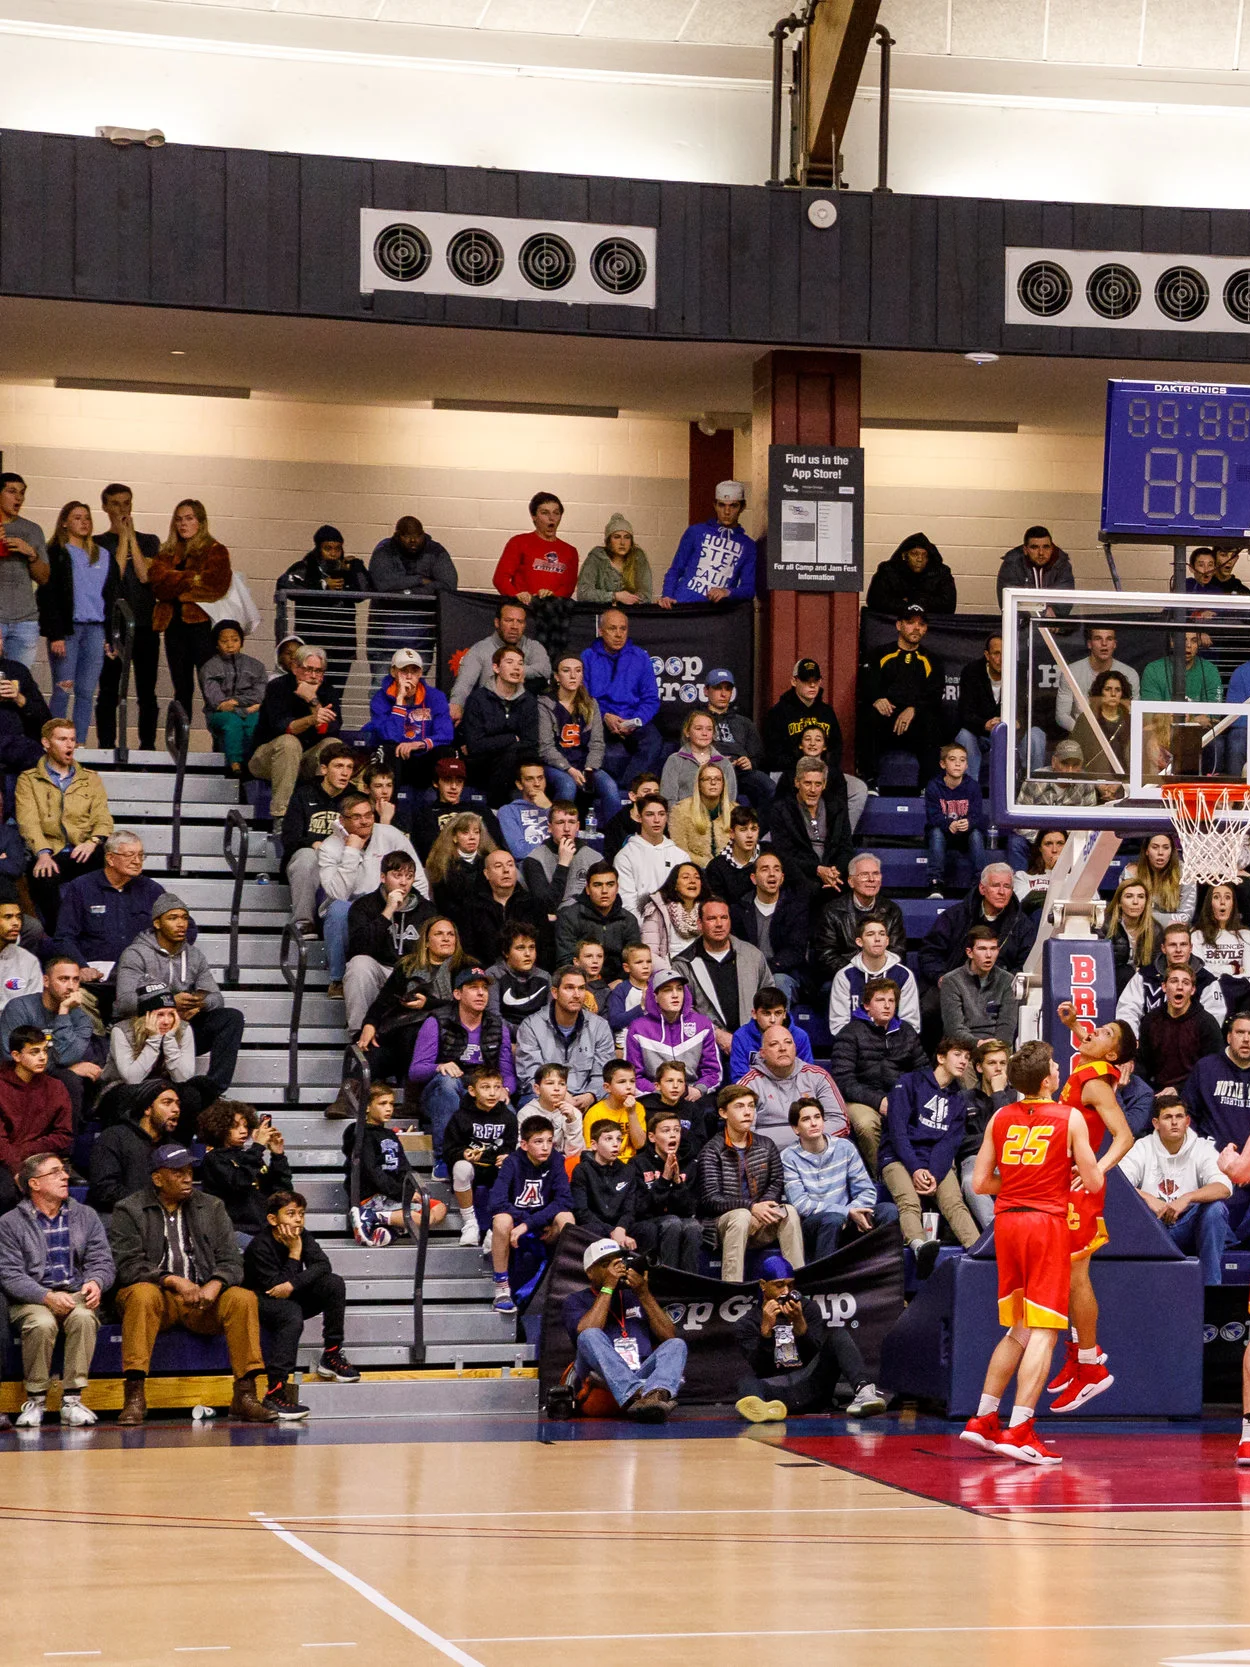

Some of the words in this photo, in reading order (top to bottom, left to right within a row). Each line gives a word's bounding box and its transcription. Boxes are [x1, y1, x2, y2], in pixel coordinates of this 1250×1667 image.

[1154, 384, 1227, 394] DAKTRONICS
[785, 453, 806, 464] Find
[808, 456, 820, 464] us
[822, 455, 831, 464] in
[833, 455, 849, 465] the
[792, 467, 811, 479] App
[813, 468, 842, 479] Store!
[774, 563, 784, 571] For
[795, 563, 814, 572] Camp
[797, 572, 835, 581] Information
[649, 655, 703, 681] oop
[559, 723, 580, 749] S
[1205, 950, 1244, 960] DEVILS
[472, 1122, 506, 1139] RFH
[1001, 1124, 1055, 1166] 25
[514, 1179, 544, 1208] A
